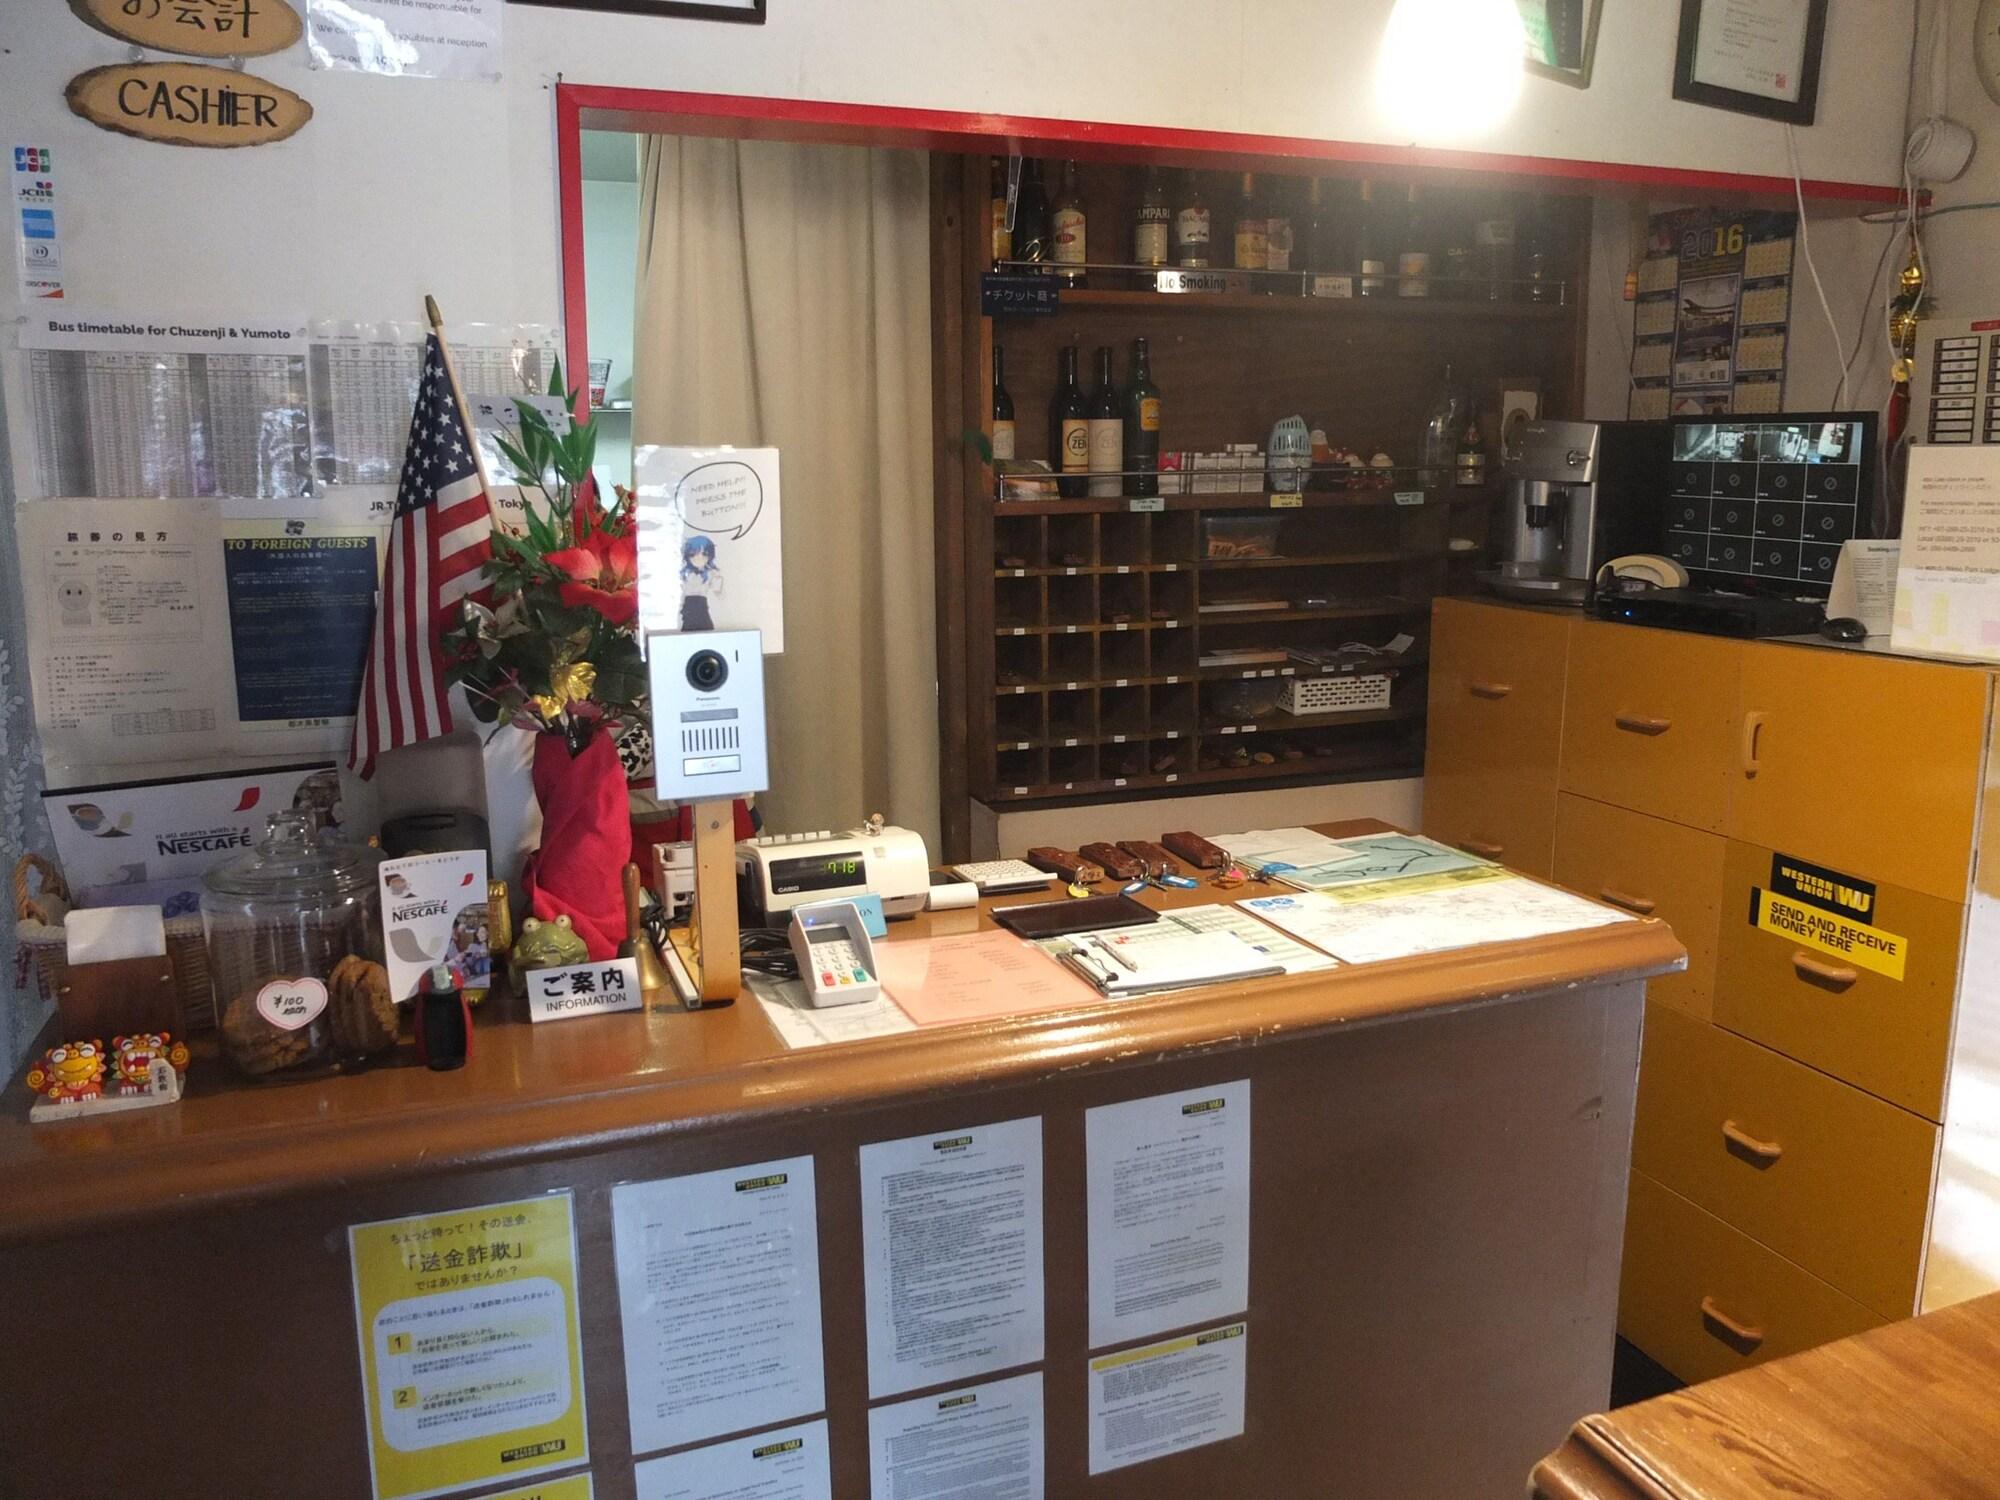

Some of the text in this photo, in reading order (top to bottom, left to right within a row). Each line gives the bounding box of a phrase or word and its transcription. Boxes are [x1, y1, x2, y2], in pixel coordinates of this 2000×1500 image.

[447, 38, 488, 48] reception
[1179, 274, 1226, 292] Smoking
[49, 321, 291, 341] Bus timetable for Chuzenji & Yumoto
[227, 537, 368, 550] TO FOREIGN GUESTS
[1781, 866, 1834, 892] WESTERN
[1795, 880, 1833, 901] UNION
[1838, 885, 1871, 913] WU
[1769, 913, 1853, 953] MONEY HERE
[1770, 901, 1897, 955] SEND AND RECEIVE
[542, 967, 626, 998] ご案内
[545, 992, 627, 1011] INFORMATION
[394, 1335, 403, 1349] 1
[397, 1390, 408, 1404] 2
